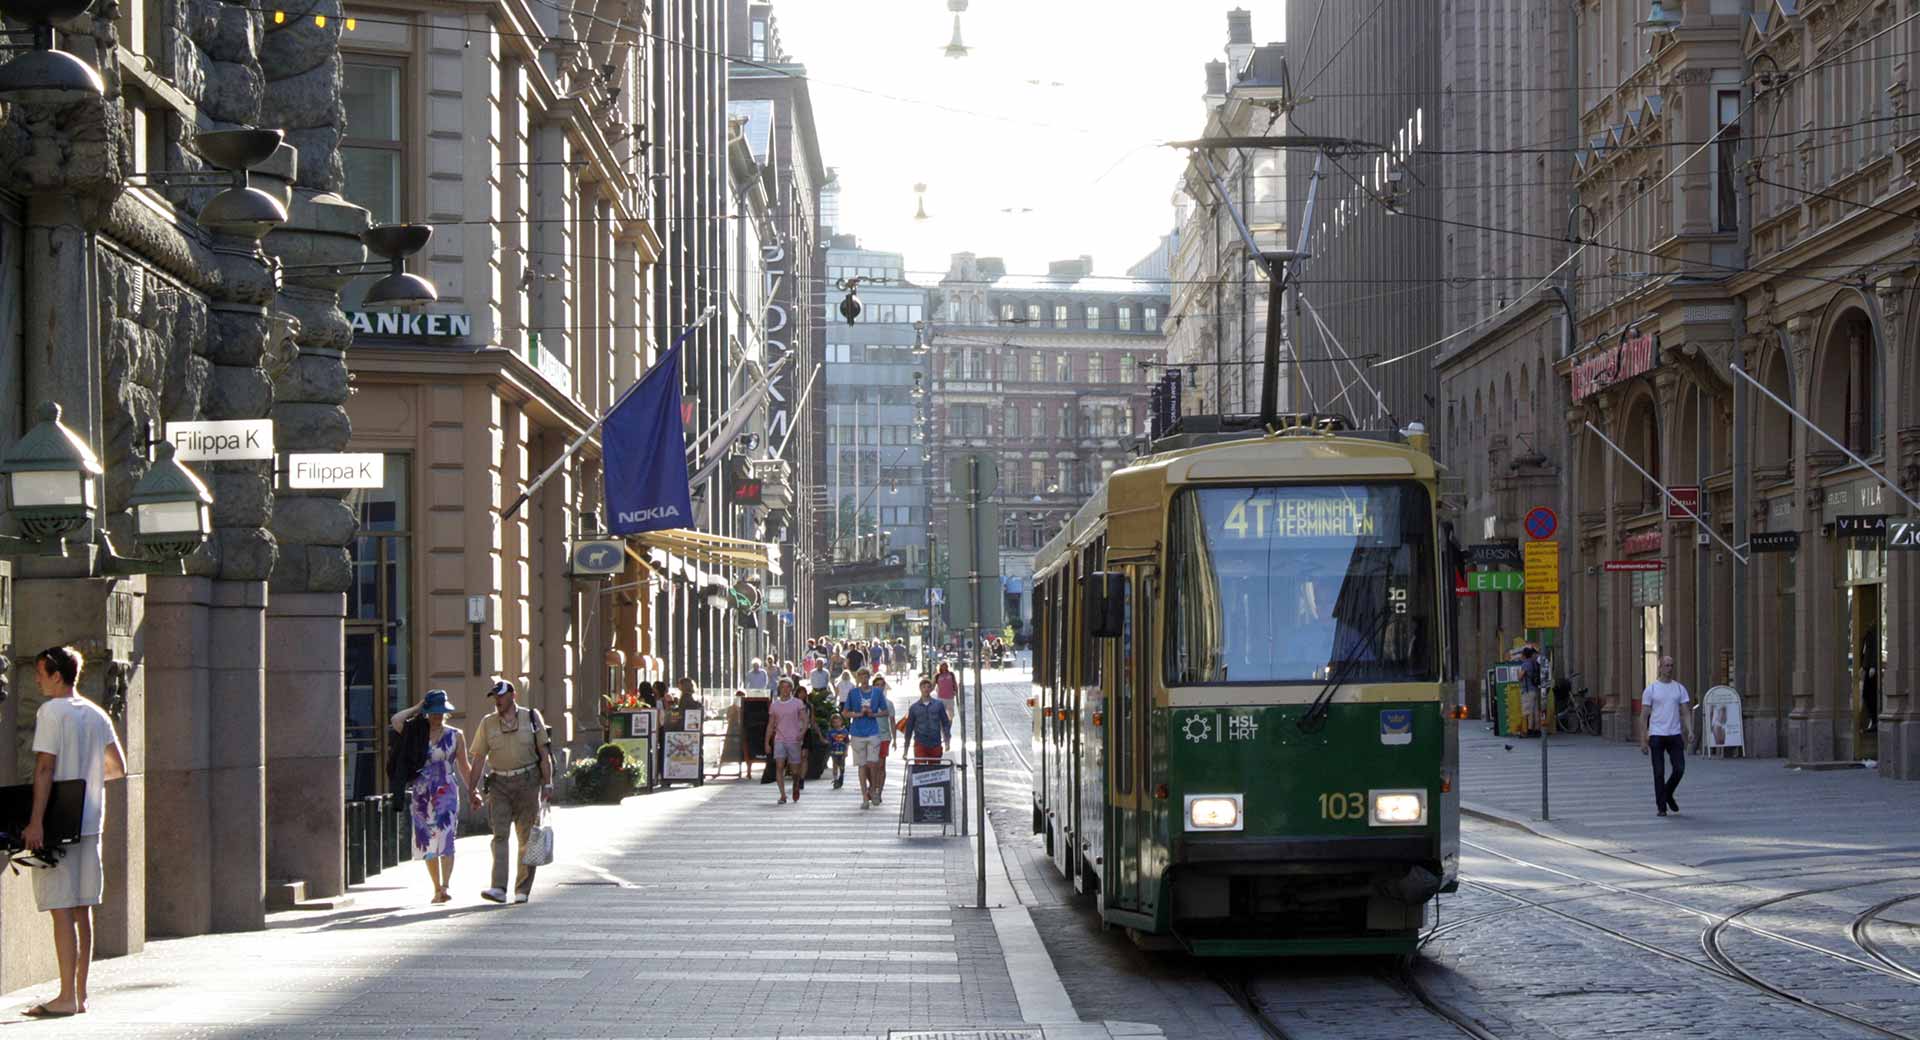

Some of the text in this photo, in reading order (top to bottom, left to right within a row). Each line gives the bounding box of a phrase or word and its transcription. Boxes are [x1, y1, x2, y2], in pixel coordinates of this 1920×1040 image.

[350, 312, 472, 336] ANKEN
[175, 429, 260, 454] Filippa K
[296, 461, 372, 482] Filippa K
[1860, 485, 1882, 508] VILA
[618, 504, 680, 524] NOKIA
[1223, 499, 1274, 539] 4T
[1839, 519, 1885, 529] VILA
[1229, 715, 1259, 727] HSL
[1229, 727, 1259, 740] HRT
[1318, 792, 1365, 820] 103
